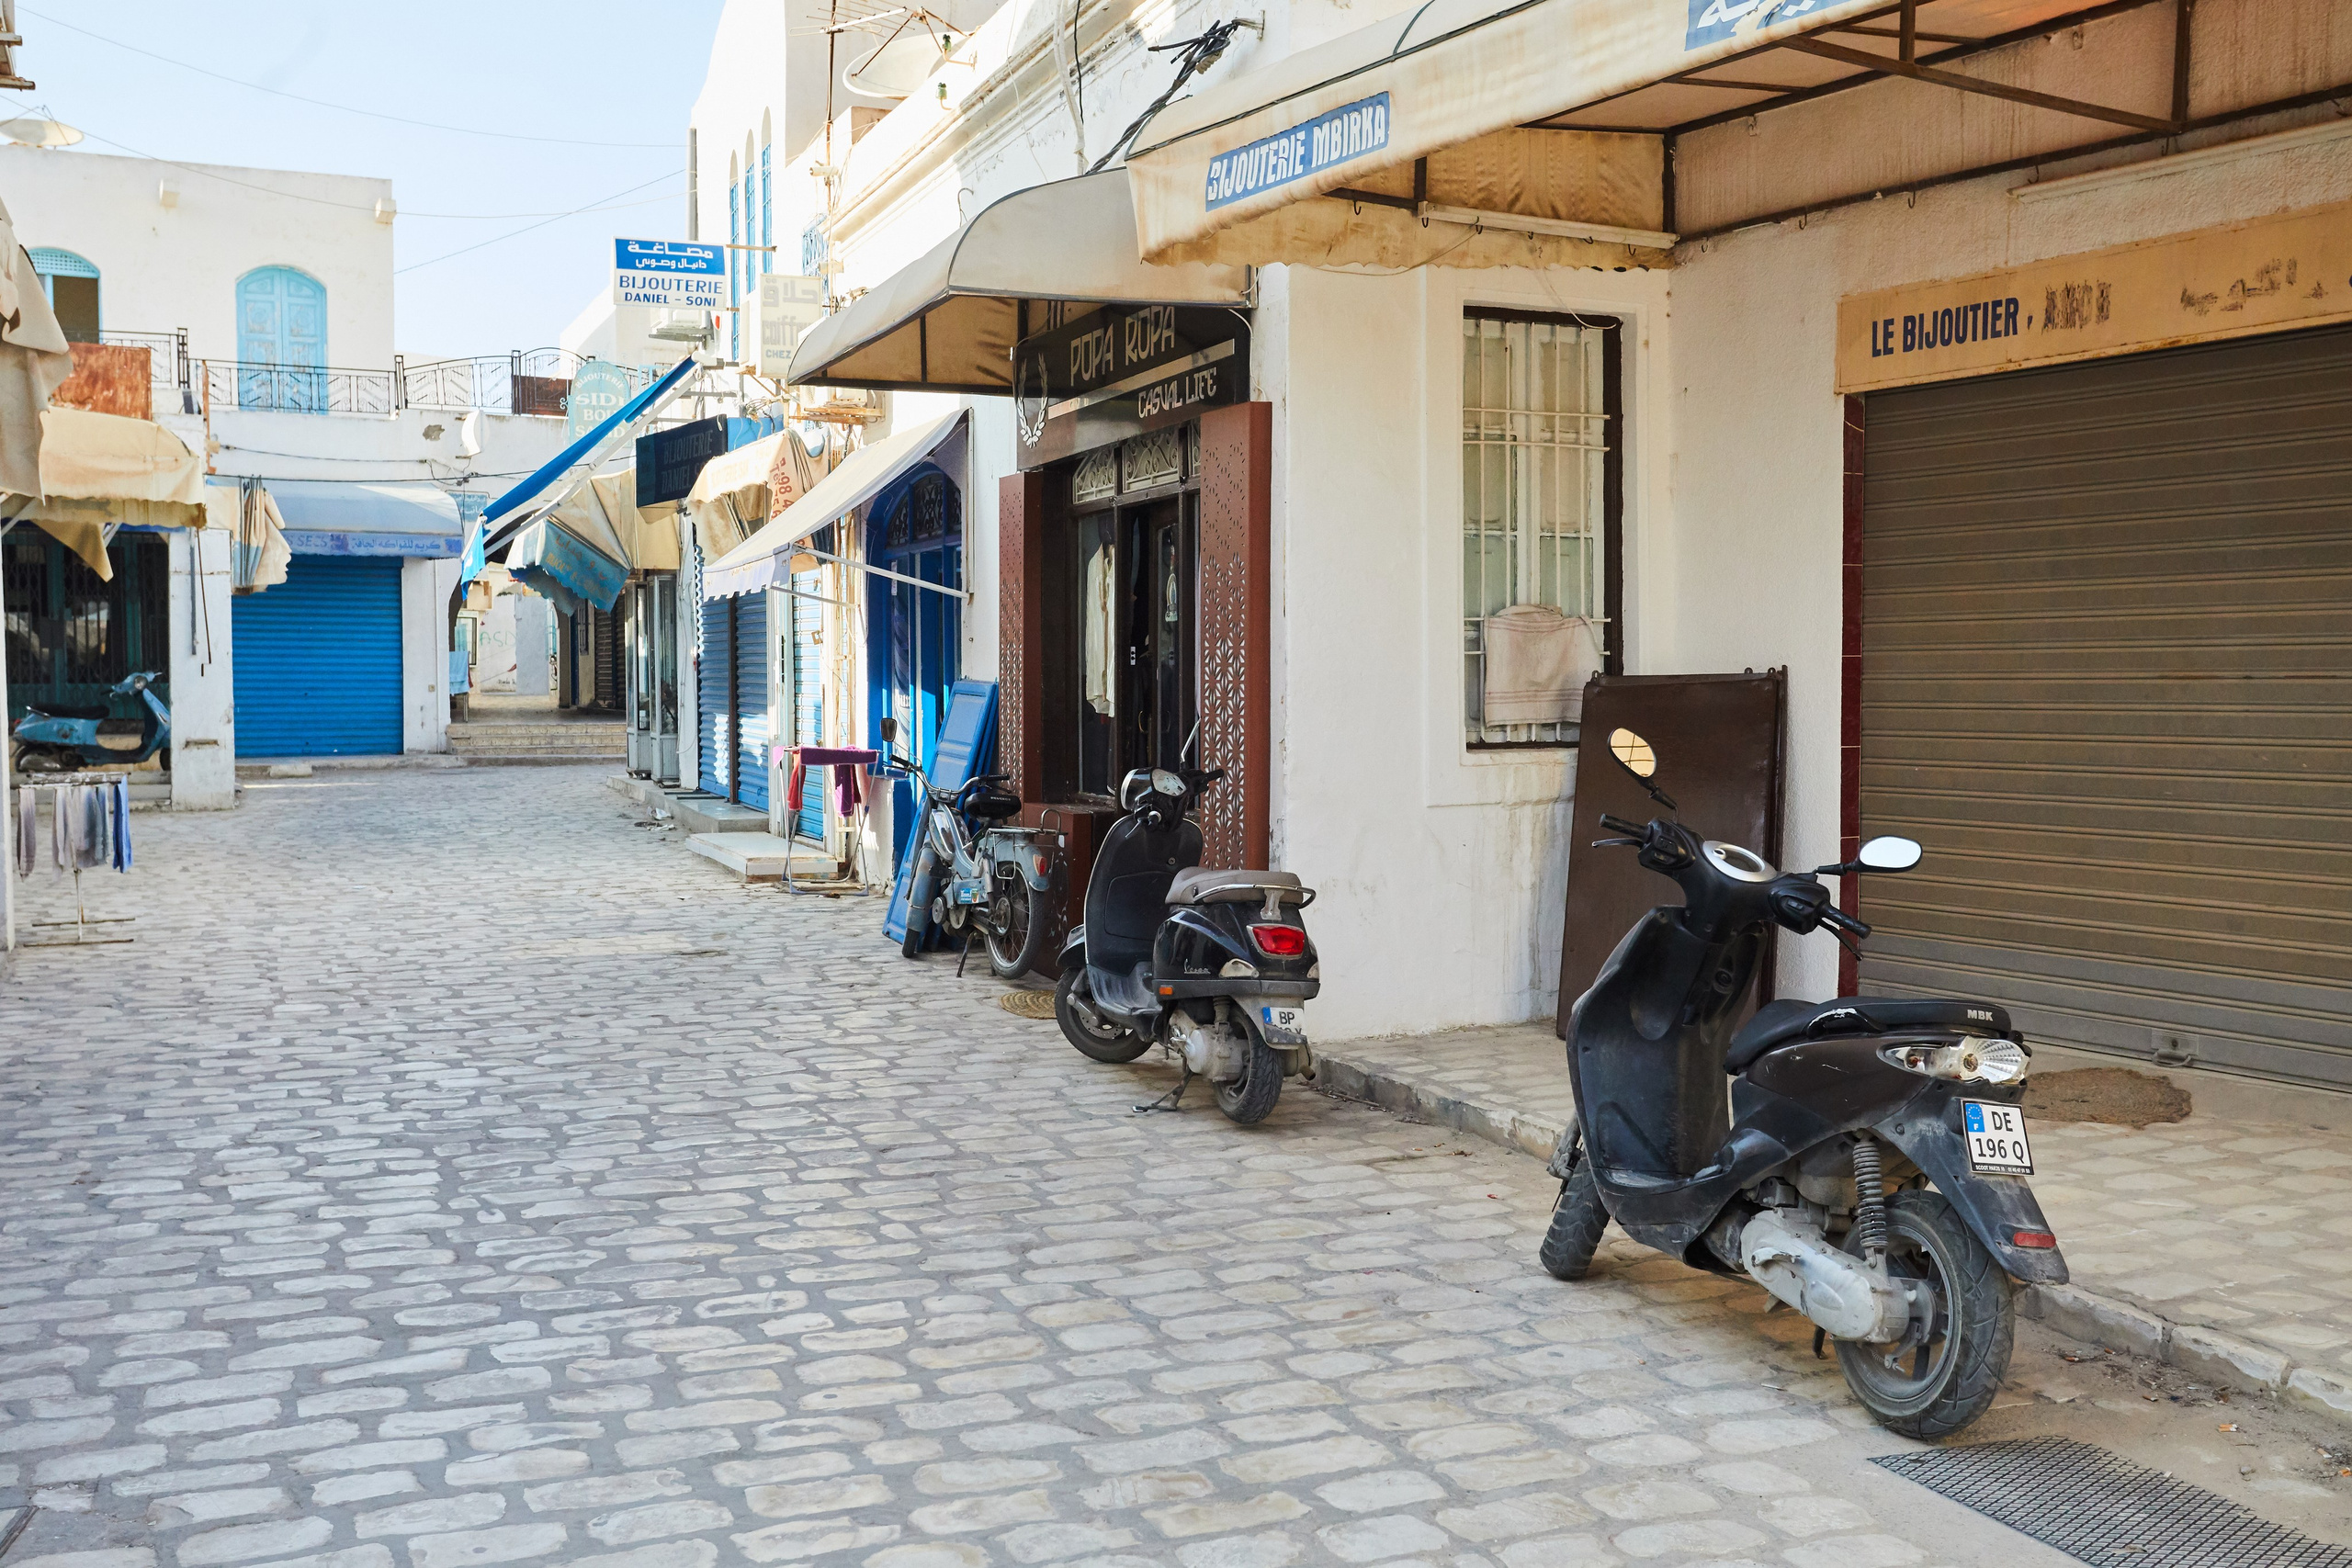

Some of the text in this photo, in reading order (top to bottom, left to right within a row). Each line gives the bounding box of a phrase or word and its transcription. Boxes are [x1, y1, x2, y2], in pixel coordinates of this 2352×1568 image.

[1207, 105, 1385, 201] BIJOUTERIE MBIRKA
[627, 241, 714, 258] مصاغة
[677, 258, 707, 269] دانيال
[619, 275, 723, 294] BIJOUTERIE
[762, 277, 818, 307] حلاق
[625, 291, 670, 304] DANIEL
[685, 296, 717, 307] SONI
[1070, 305, 1175, 387] POPA ROPA
[1871, 318, 1894, 357] LE
[765, 349, 792, 359] CHEZ
[575, 372, 626, 389] BIJOUTERIE
[1138, 367, 1216, 419] CASUAL LIFE
[663, 430, 714, 466] BIJOUTERIE
[661, 465, 693, 495] DANIEL
[1183, 958, 1212, 975] Vespa
[1278, 1011, 1295, 1024] BP
[1967, 1009, 1994, 1021] MBK
[1992, 1111, 2013, 1132] DE
[1975, 1138, 2025, 1164] 196 Q
